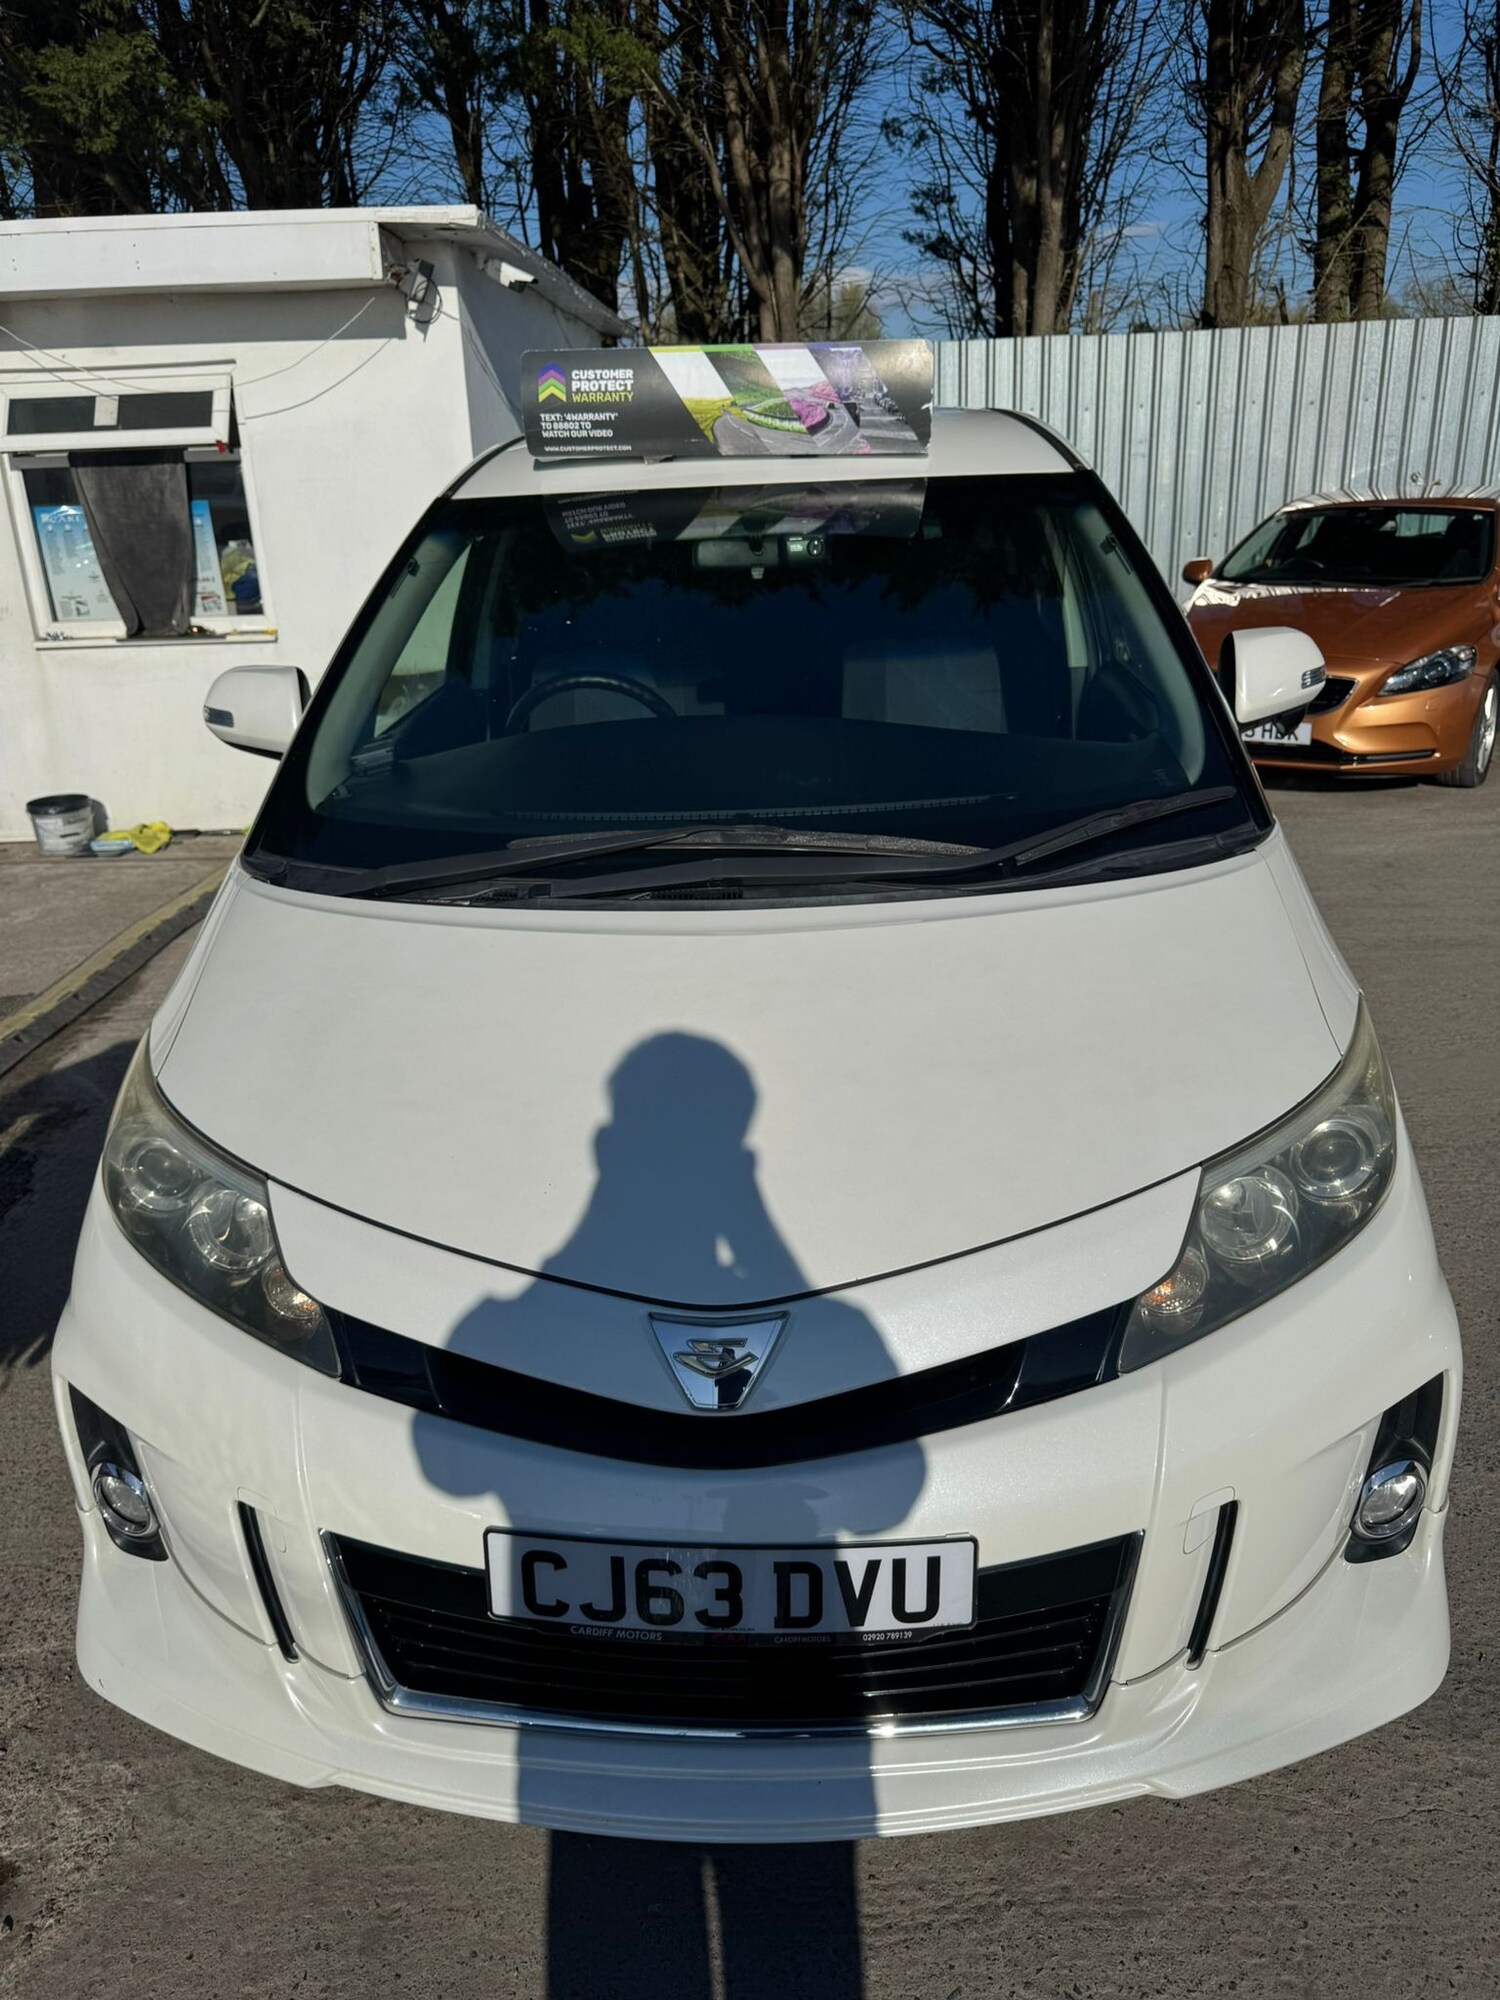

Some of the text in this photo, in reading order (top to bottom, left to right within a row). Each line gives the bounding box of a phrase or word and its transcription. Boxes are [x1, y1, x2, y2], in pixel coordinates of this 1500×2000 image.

[571, 369, 634, 380] CUSTOMER
[571, 380, 634, 392] PROTECT
[572, 392, 634, 403] WARRANTY
[540, 413, 563, 422] TEXT:
[541, 421, 592, 430] TO 88802 TO
[541, 429, 613, 438] WATCH OUR VIDEO
[521, 1549, 942, 1629] CJ63 DVU
[570, 1625, 663, 1641] CARDIFF MOTORS
[863, 1631, 913, 1642] 02920 789139
